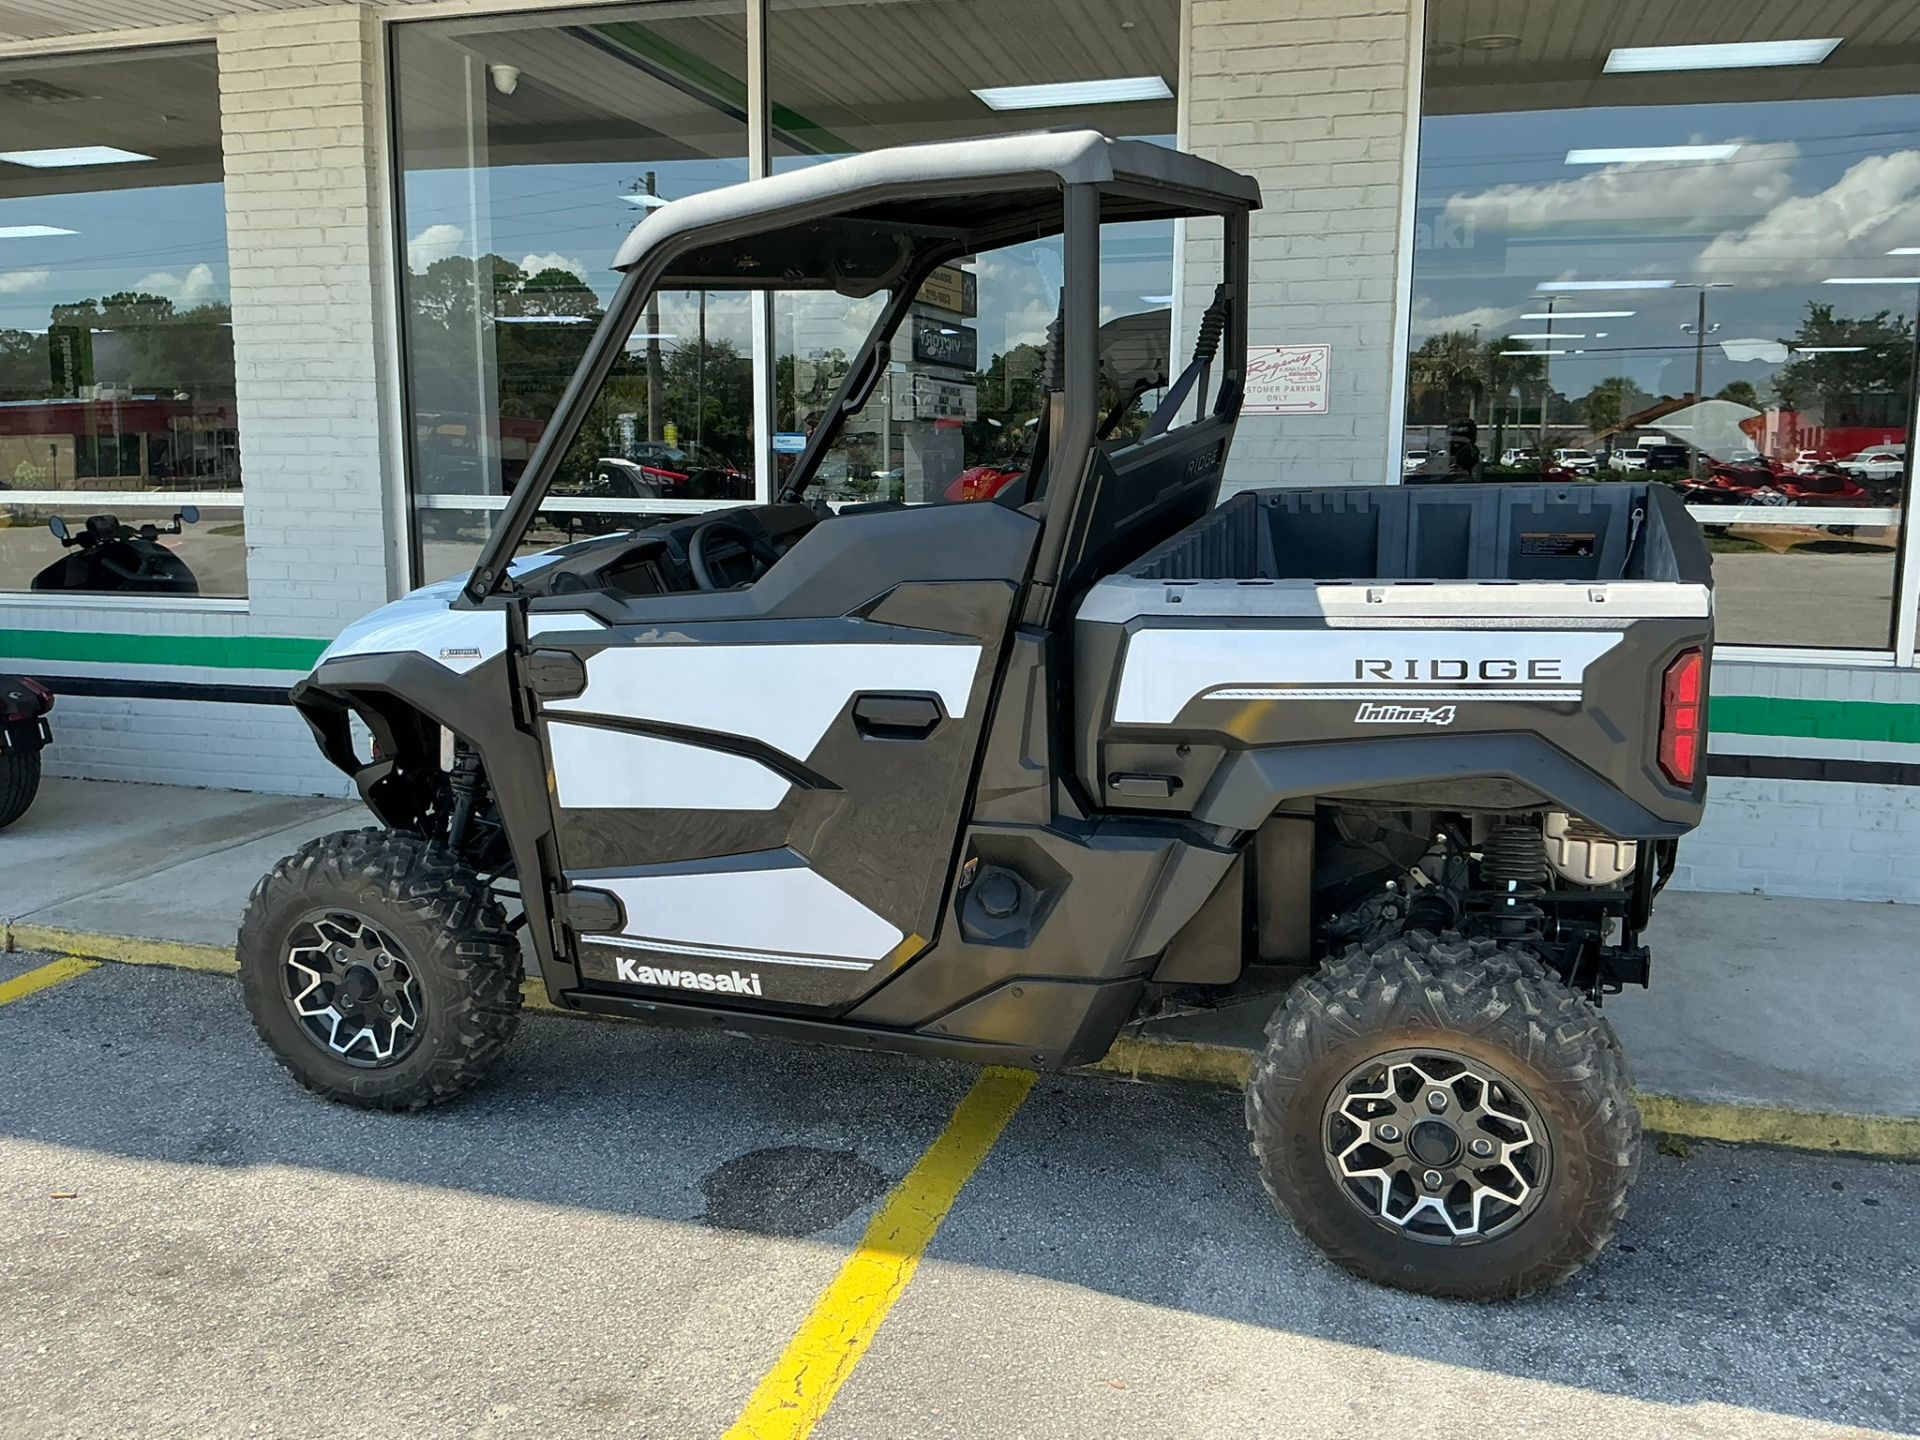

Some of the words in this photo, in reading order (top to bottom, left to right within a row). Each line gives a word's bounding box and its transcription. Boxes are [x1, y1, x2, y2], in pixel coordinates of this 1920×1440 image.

[60, 335, 75, 398] Kawasaki
[1247, 353, 1312, 379] Regency
[1246, 386, 1281, 394] STOMER
[1284, 385, 1321, 393] PARKING
[1266, 394, 1288, 402] ONLY
[1186, 449, 1218, 477] RIDGE
[1354, 659, 1562, 681] RIDGE
[1354, 702, 1457, 726] Inline-4
[615, 956, 763, 997] Kawasaki
